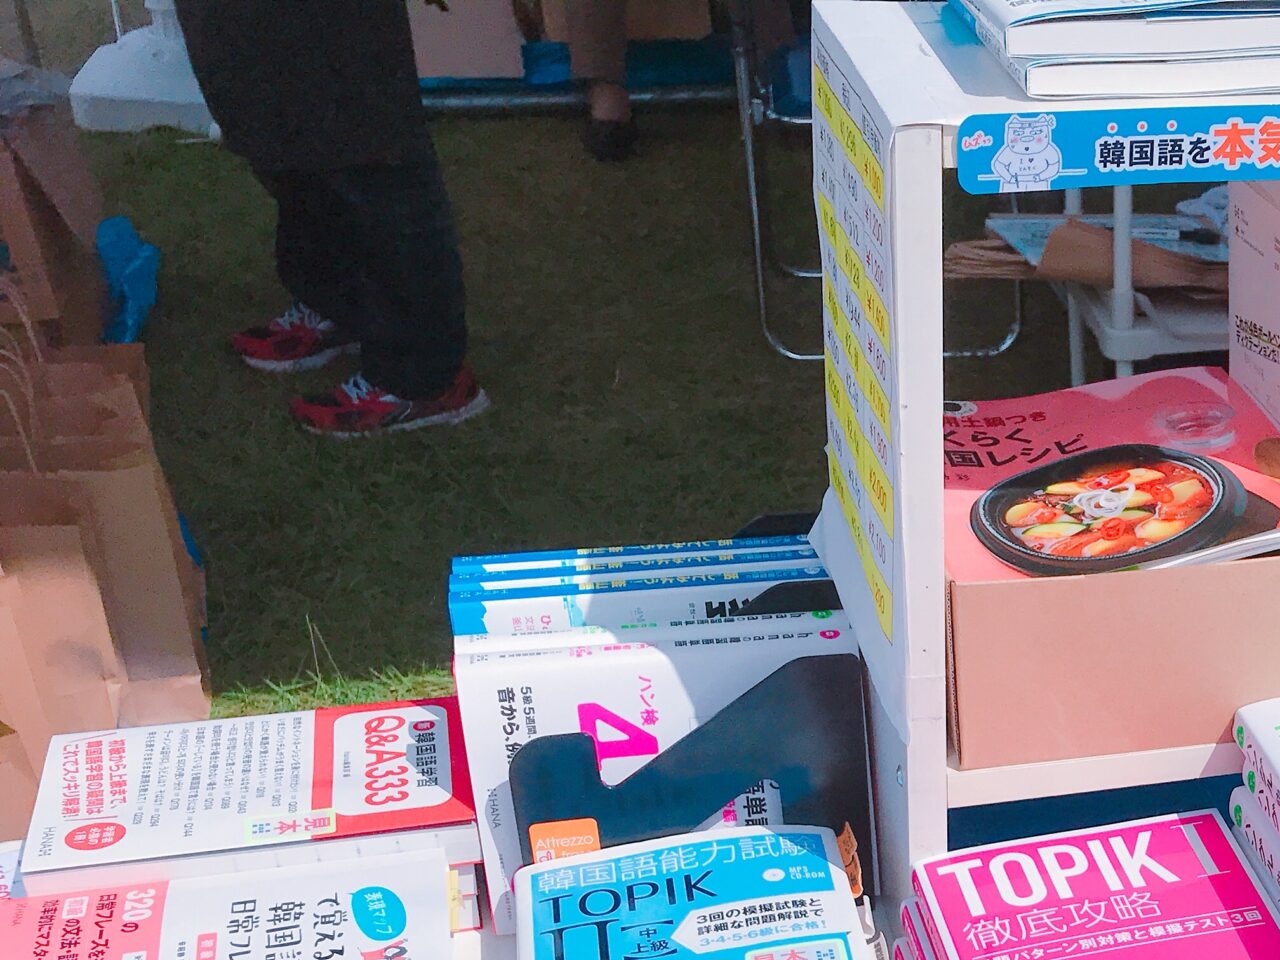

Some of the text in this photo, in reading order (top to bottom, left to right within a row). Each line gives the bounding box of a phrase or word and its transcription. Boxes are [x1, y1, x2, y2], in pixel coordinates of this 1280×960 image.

[637, 674, 660, 727] ハン検
[107, 738, 129, 810] 初級から上級まで、
[363, 716, 410, 807] Q&A333
[273, 815, 332, 836] 見本
[538, 869, 718, 924] TOPIK
[936, 830, 1181, 918] TOPIK
[695, 897, 823, 924] 3回の模擬試験と
[697, 908, 825, 936] 詳細な問題解説で
[962, 890, 1163, 952] 徹底攻略
